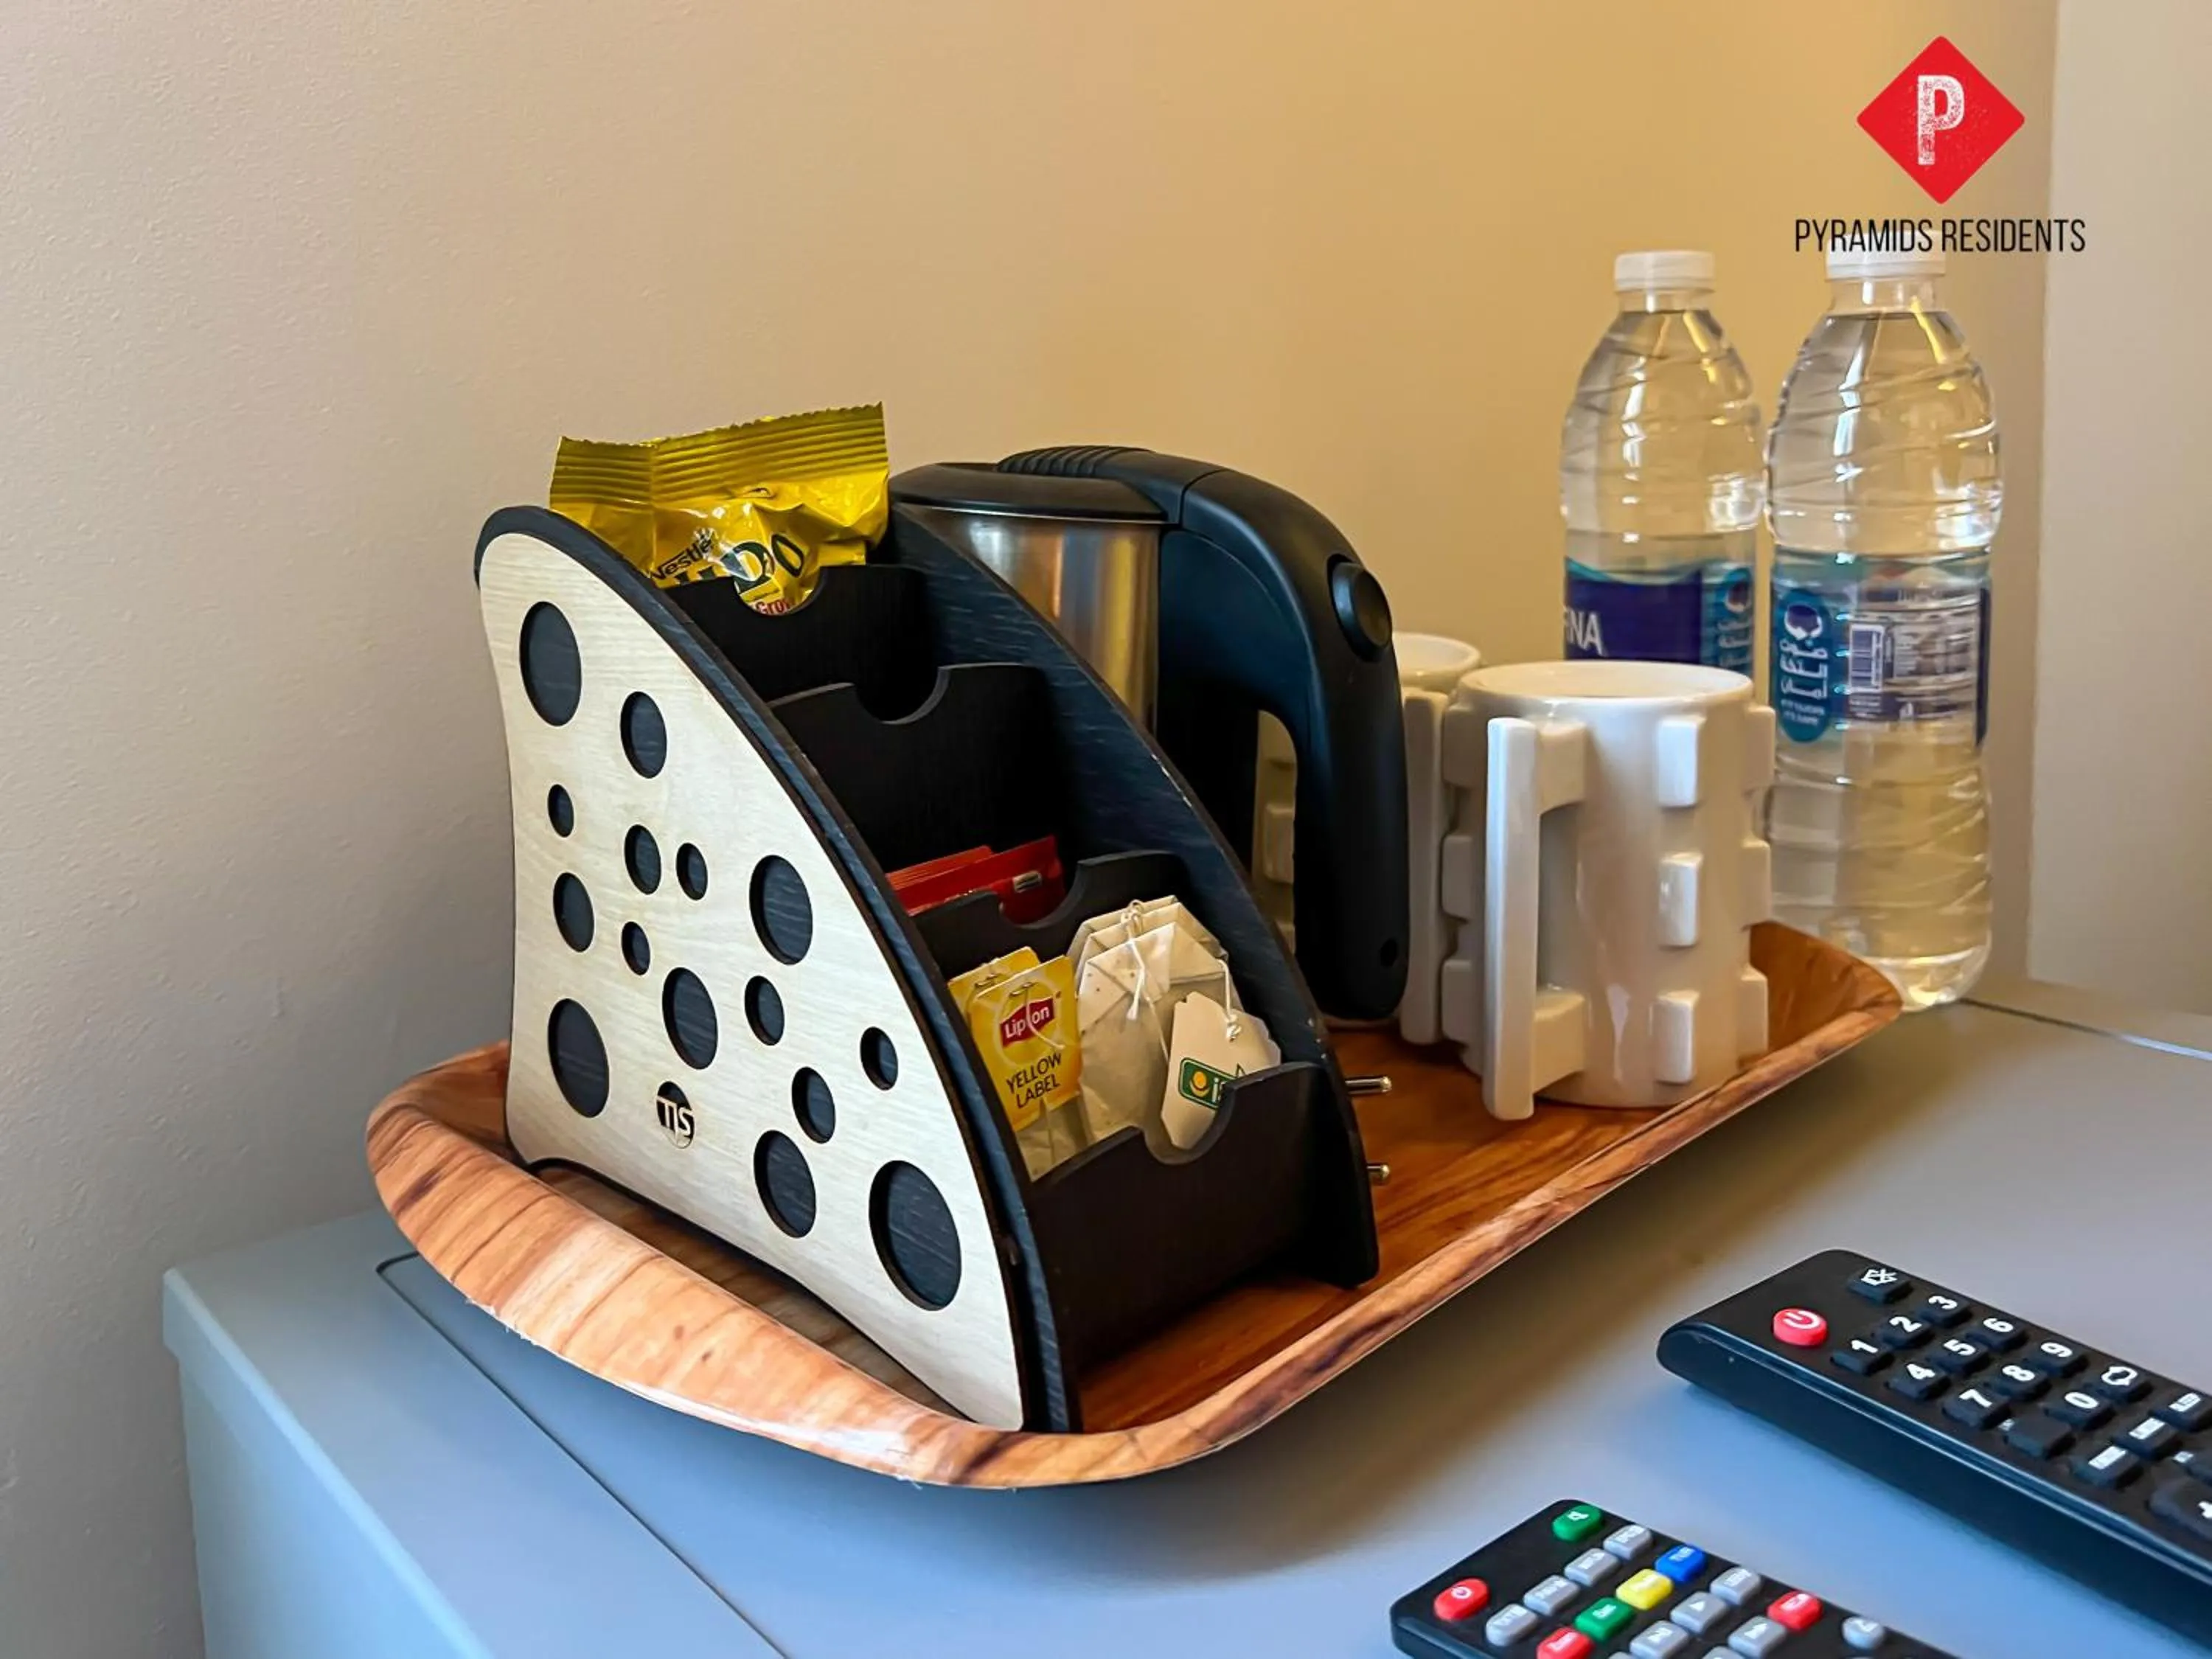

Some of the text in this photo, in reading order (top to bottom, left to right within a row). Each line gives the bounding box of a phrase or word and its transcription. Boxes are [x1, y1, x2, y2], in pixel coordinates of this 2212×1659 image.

[1564, 609, 1607, 656] NA
[1004, 1006, 1050, 1038] Lipon
[1006, 1051, 1062, 1094] YELLOW
[1016, 1073, 1061, 1109] LABEL
[1851, 1295, 1958, 1354] 1 2 3
[1907, 1317, 2014, 1380] 4 5 6
[1959, 1341, 2073, 1408] 7 8 9
[2064, 1391, 2099, 1409] 0
